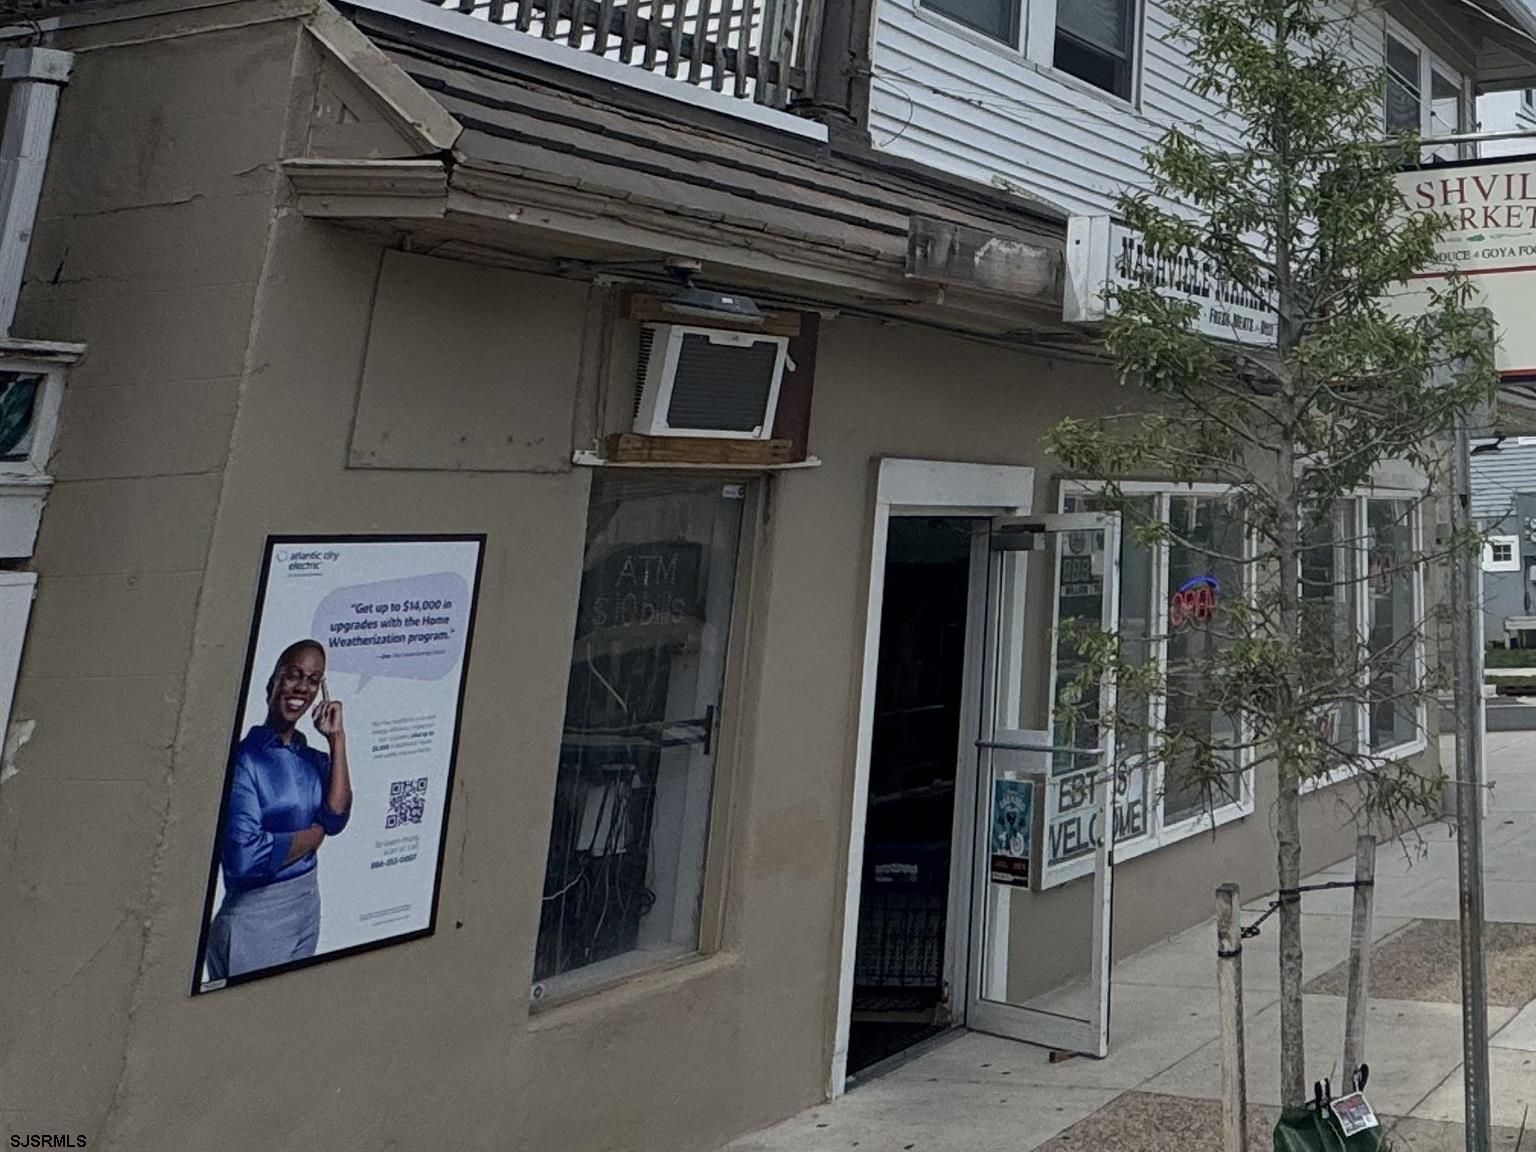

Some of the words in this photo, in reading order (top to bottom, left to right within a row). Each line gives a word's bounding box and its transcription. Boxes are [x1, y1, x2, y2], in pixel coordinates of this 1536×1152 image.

[1434, 249, 1471, 262] DUCE
[1481, 246, 1516, 260] GOYA
[290, 550, 322, 561] atlantic
[323, 550, 340, 562] city
[288, 561, 320, 571] electric
[614, 553, 679, 587] ATM
[375, 605, 389, 615] up
[390, 601, 401, 611] to
[443, 599, 452, 609] in
[330, 617, 378, 633] upgrades
[380, 617, 402, 628] with
[404, 616, 420, 627] the
[422, 615, 450, 626] Home
[328, 631, 406, 648] Weatherization
[1059, 769, 1099, 813] EBT
